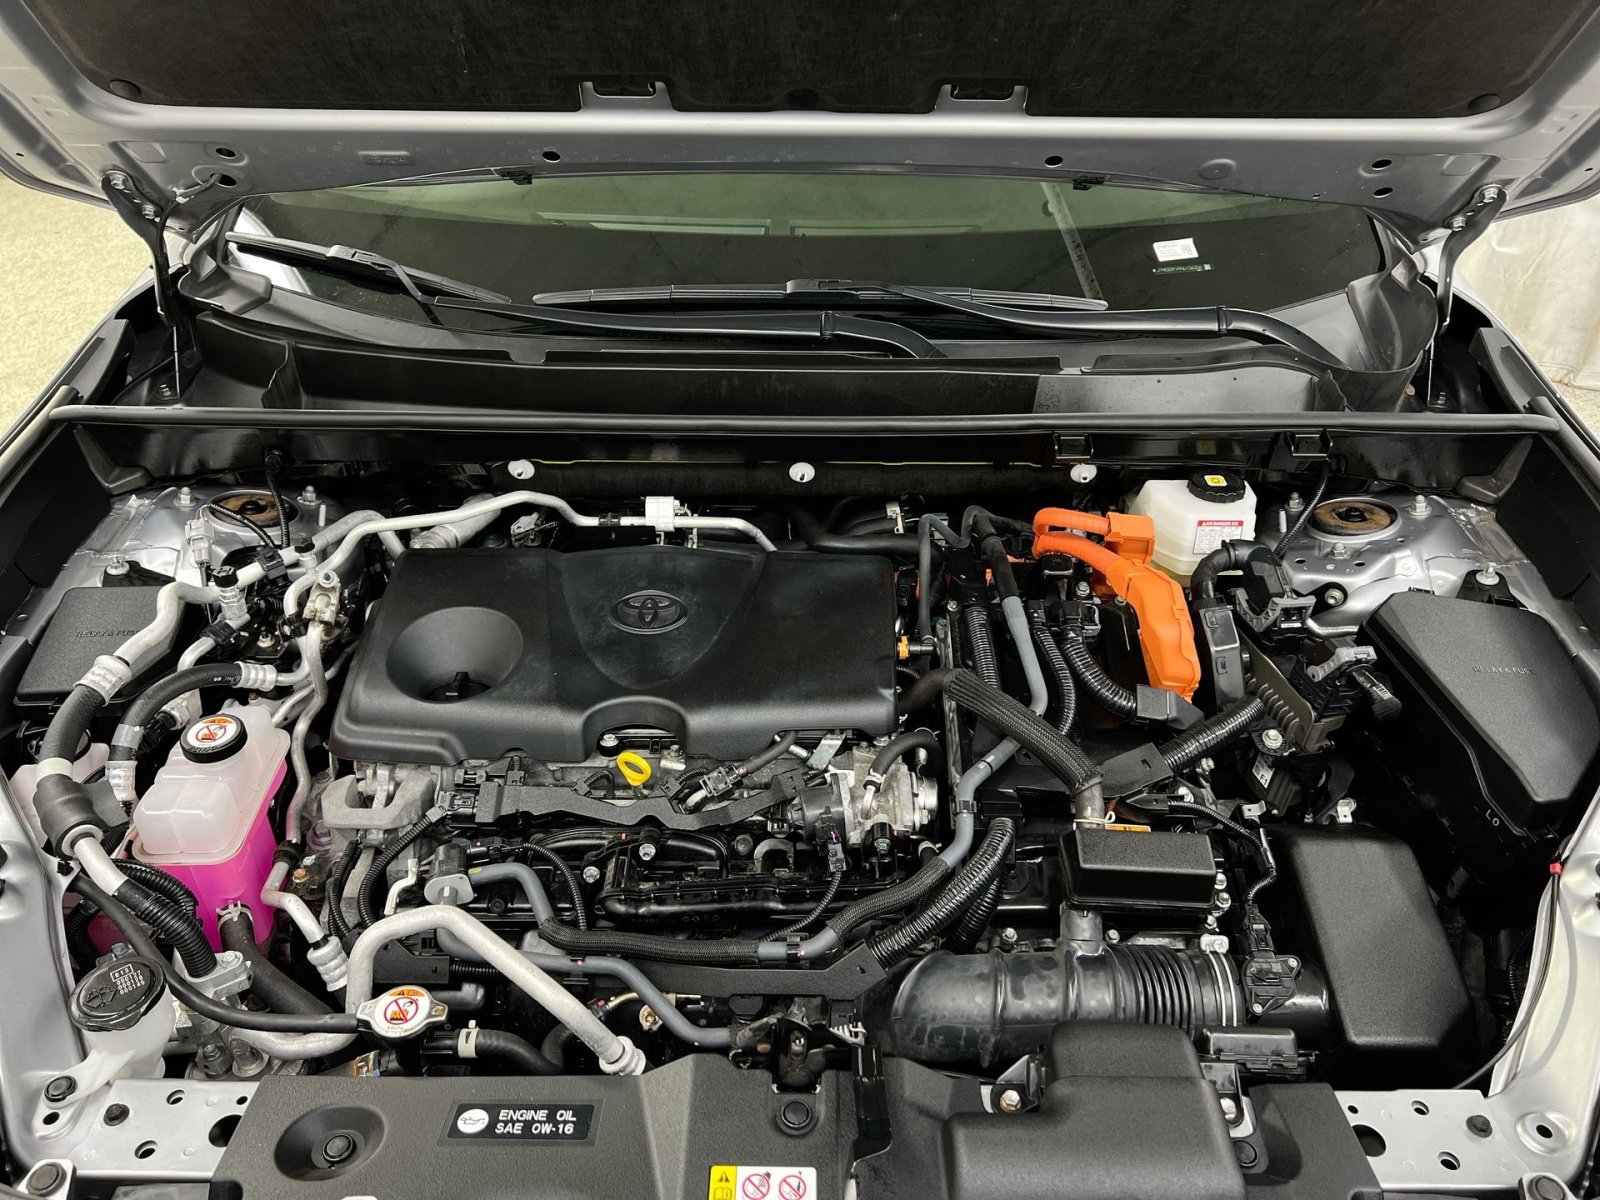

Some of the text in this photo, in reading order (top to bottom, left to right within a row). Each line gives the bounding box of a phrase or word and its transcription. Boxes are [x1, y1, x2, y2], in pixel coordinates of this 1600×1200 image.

[498, 1109, 577, 1121] ENGINE OIL
[494, 1122, 575, 1135] SAE 0W-16
